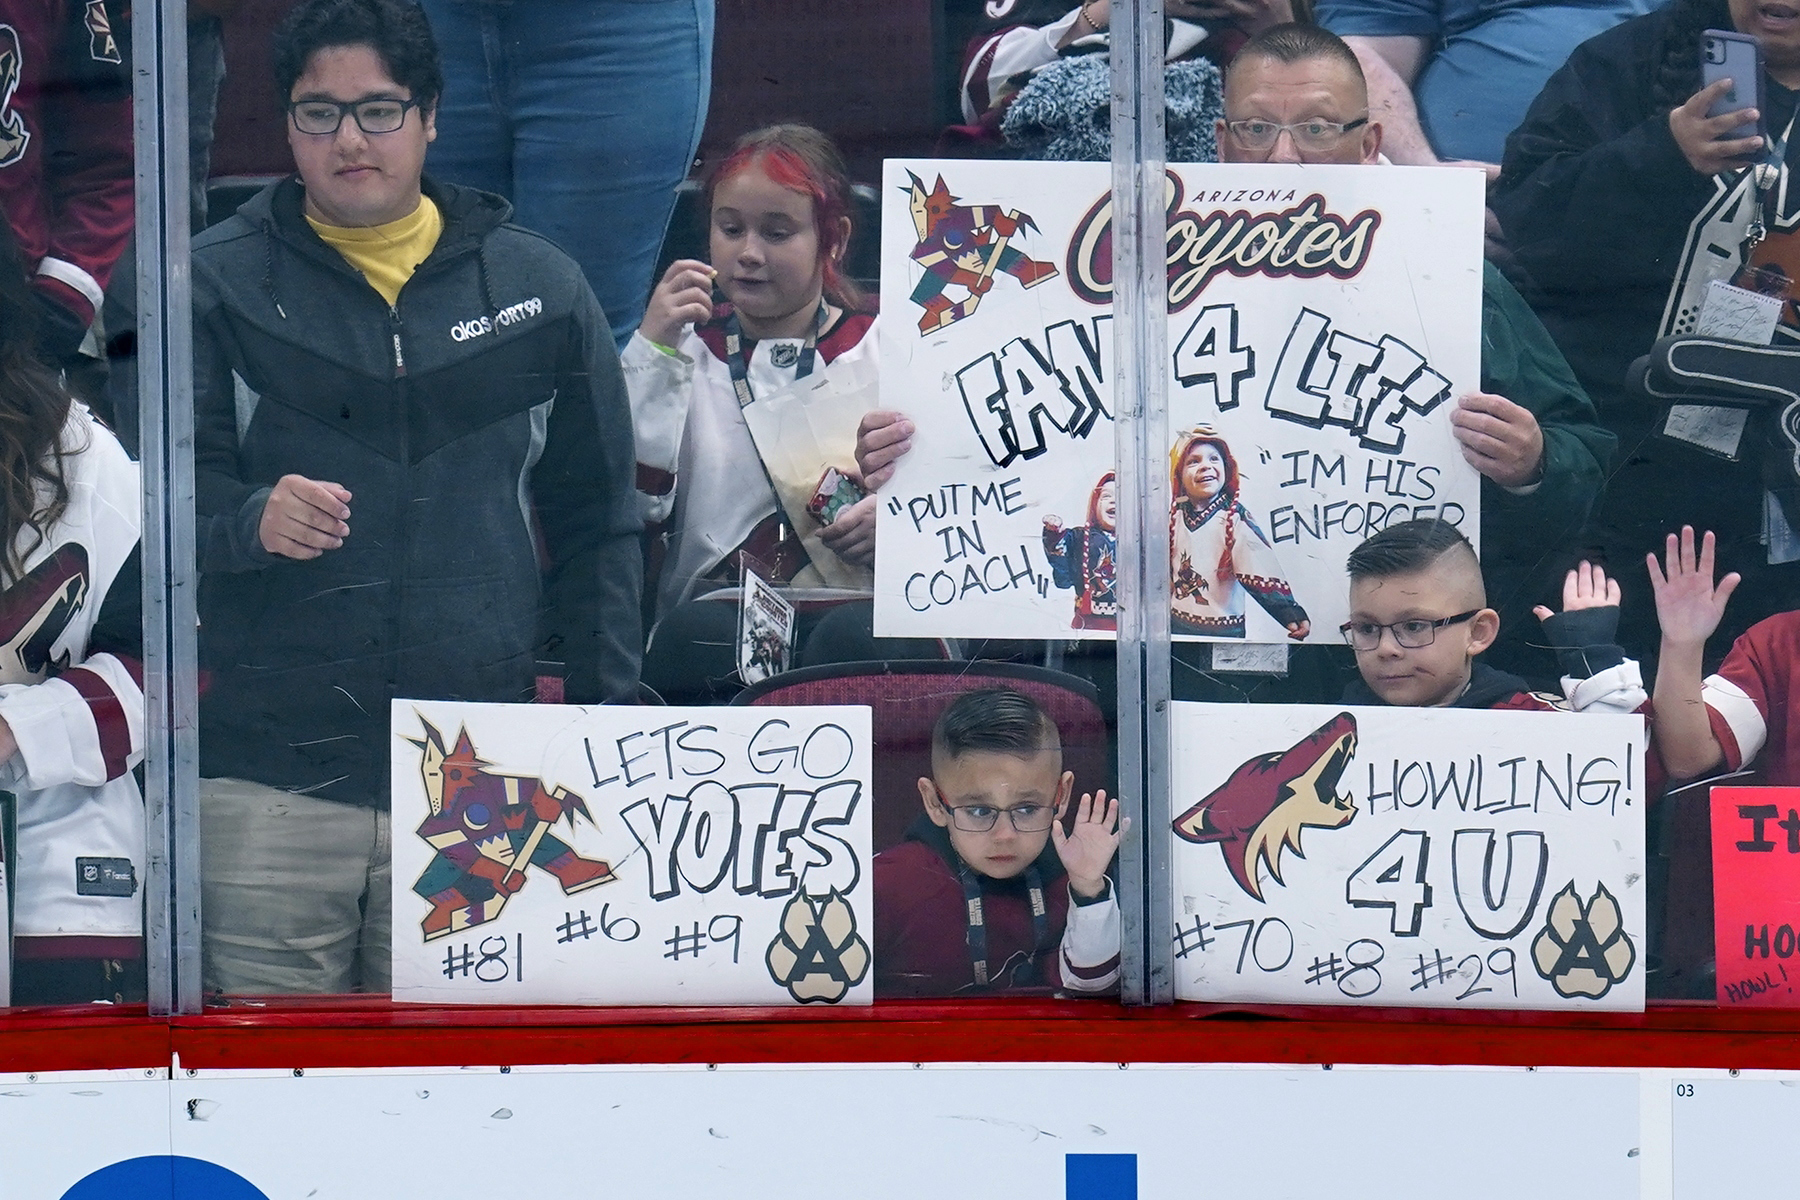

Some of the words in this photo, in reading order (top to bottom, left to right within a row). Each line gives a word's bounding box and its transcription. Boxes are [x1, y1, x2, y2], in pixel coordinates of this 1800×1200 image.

[1192, 188, 1297, 203] ARIZONA
[1070, 167, 1379, 310] Coyotes
[1173, 303, 1256, 412] 4
[1264, 306, 1452, 455] LIFE
[1365, 459, 1441, 500] HIS
[935, 519, 986, 563] IN
[584, 720, 726, 788] LETS
[747, 719, 854, 779] GO
[1367, 743, 1633, 816] HOWLING!
[619, 779, 862, 902] YOTES
[555, 903, 641, 945] #6
[663, 914, 744, 964] #9
[1172, 915, 1294, 975] #70
[441, 932, 524, 983] #81
[1305, 938, 1385, 998] #8
[1410, 946, 1518, 1000] #29
[1676, 1083, 1696, 1098] 03
